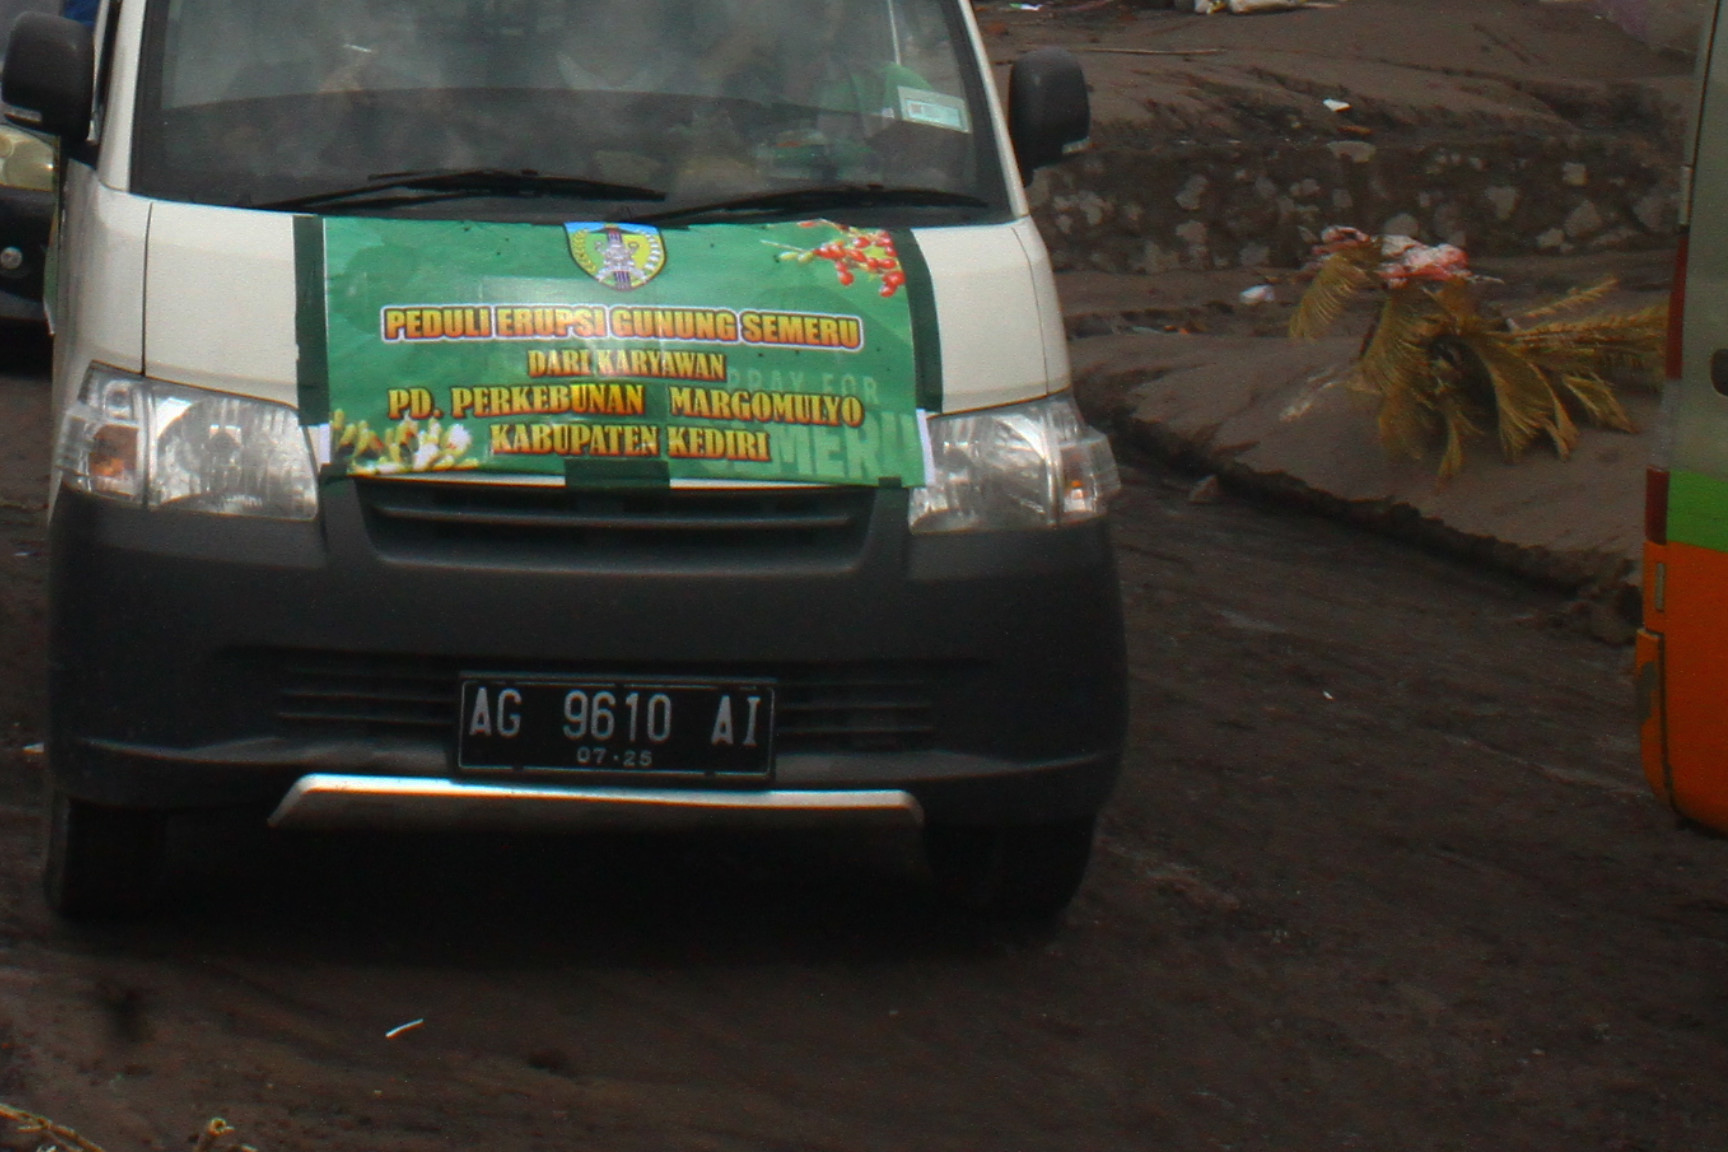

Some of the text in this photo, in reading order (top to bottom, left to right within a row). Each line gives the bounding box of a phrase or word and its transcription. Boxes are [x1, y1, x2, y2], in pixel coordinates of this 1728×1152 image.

[383, 306, 860, 349] PEDULI ERUPSI GUNUNG SEMERU
[527, 349, 728, 381] DARI KARYAWAN
[387, 384, 866, 427] PD. PERKEBUNAN MARGOMULYO
[490, 423, 772, 462] KABUPATEN KEDIRI
[469, 686, 761, 746] AG 9610 AI
